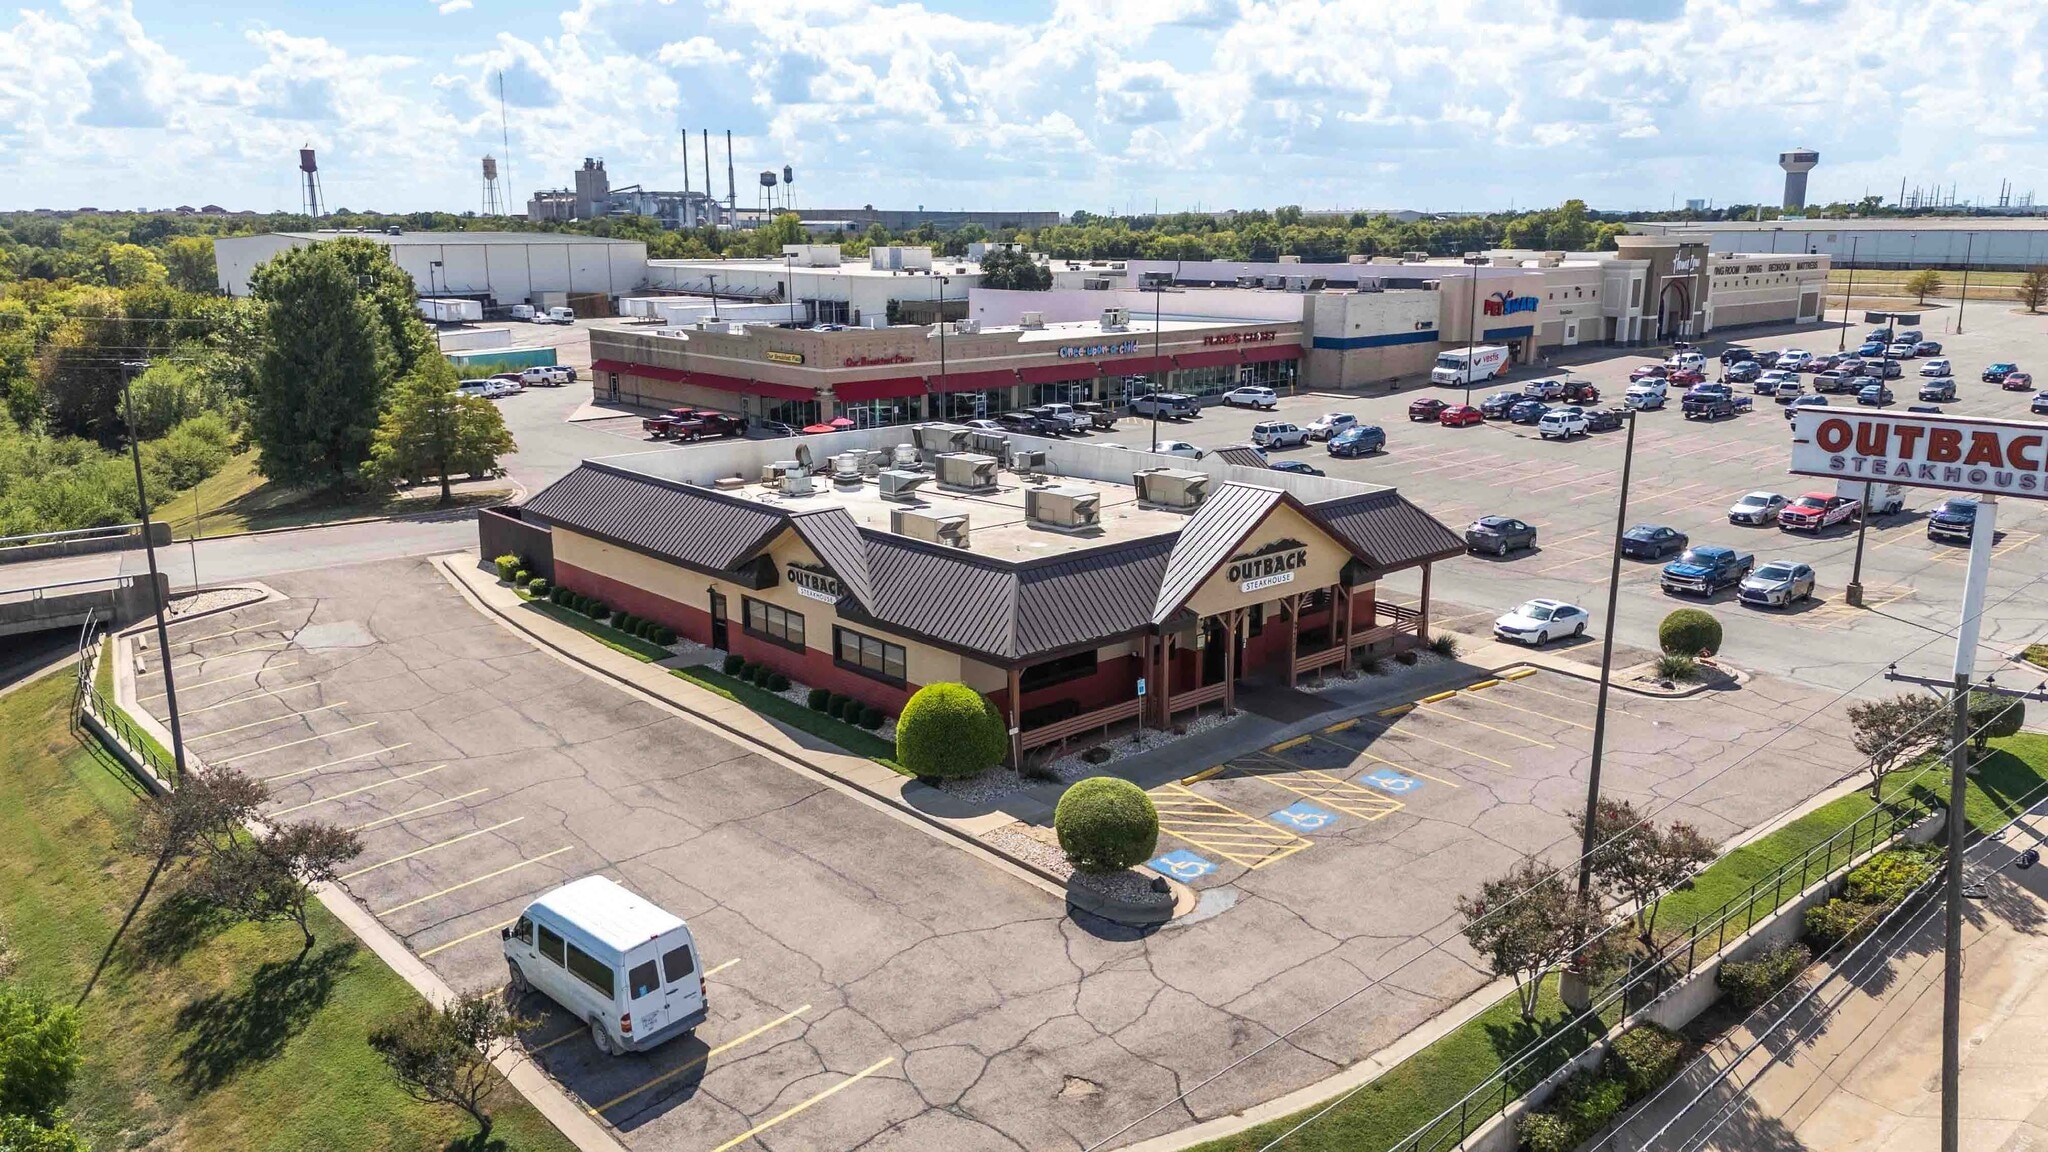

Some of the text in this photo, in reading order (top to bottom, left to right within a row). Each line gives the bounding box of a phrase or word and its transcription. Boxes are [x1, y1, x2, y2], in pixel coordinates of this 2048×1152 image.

[1768, 263, 1790, 272] BEDROOM
[1059, 346, 1084, 358] Once
[1086, 344, 1109, 357] upon
[1119, 340, 1139, 354] child
[1483, 352, 1500, 363] vestis
[1816, 418, 2048, 473] OUTBAC
[1829, 455, 2048, 491] STEAKHOUS
[1229, 550, 1307, 582] OUTBACK
[1246, 574, 1291, 591] STEAKHOUSE
[800, 588, 834, 603] STEAKHOUSE
